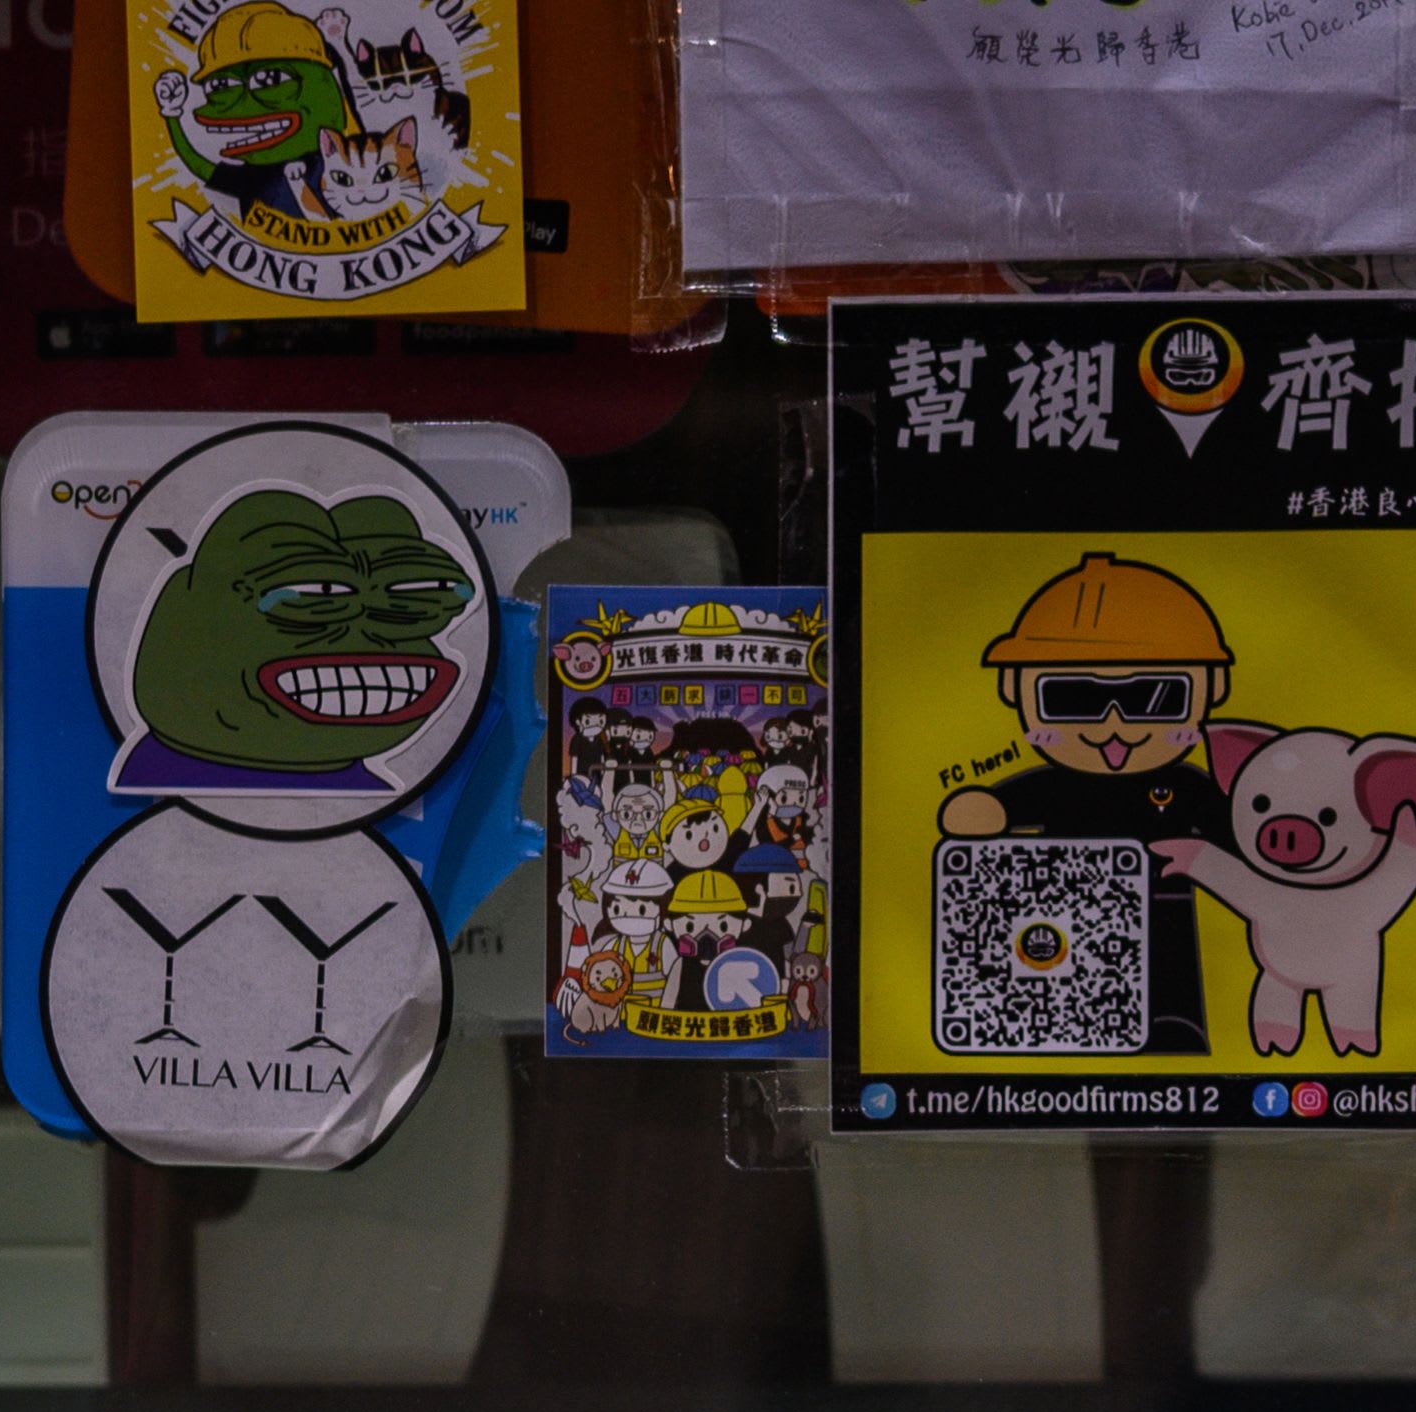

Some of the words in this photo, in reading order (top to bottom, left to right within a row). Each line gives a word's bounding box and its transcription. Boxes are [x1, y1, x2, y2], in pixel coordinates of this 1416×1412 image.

[249, 205, 332, 247] STAND
[338, 207, 407, 246] WITH
[195, 209, 320, 296] HONG
[341, 210, 463, 295] KONG
[889, 337, 1121, 454] 幫襯
[616, 643, 703, 669] 光復香港
[715, 643, 804, 668] 時代革命
[940, 764, 968, 789] FC
[971, 742, 1022, 781] here!
[636, 1010, 778, 1038] 願榮光歸香港
[133, 1055, 238, 1090] VILLA
[246, 1060, 352, 1095] VILLA
[907, 1084, 1220, 1116] t.me/hkgoodfirms812
